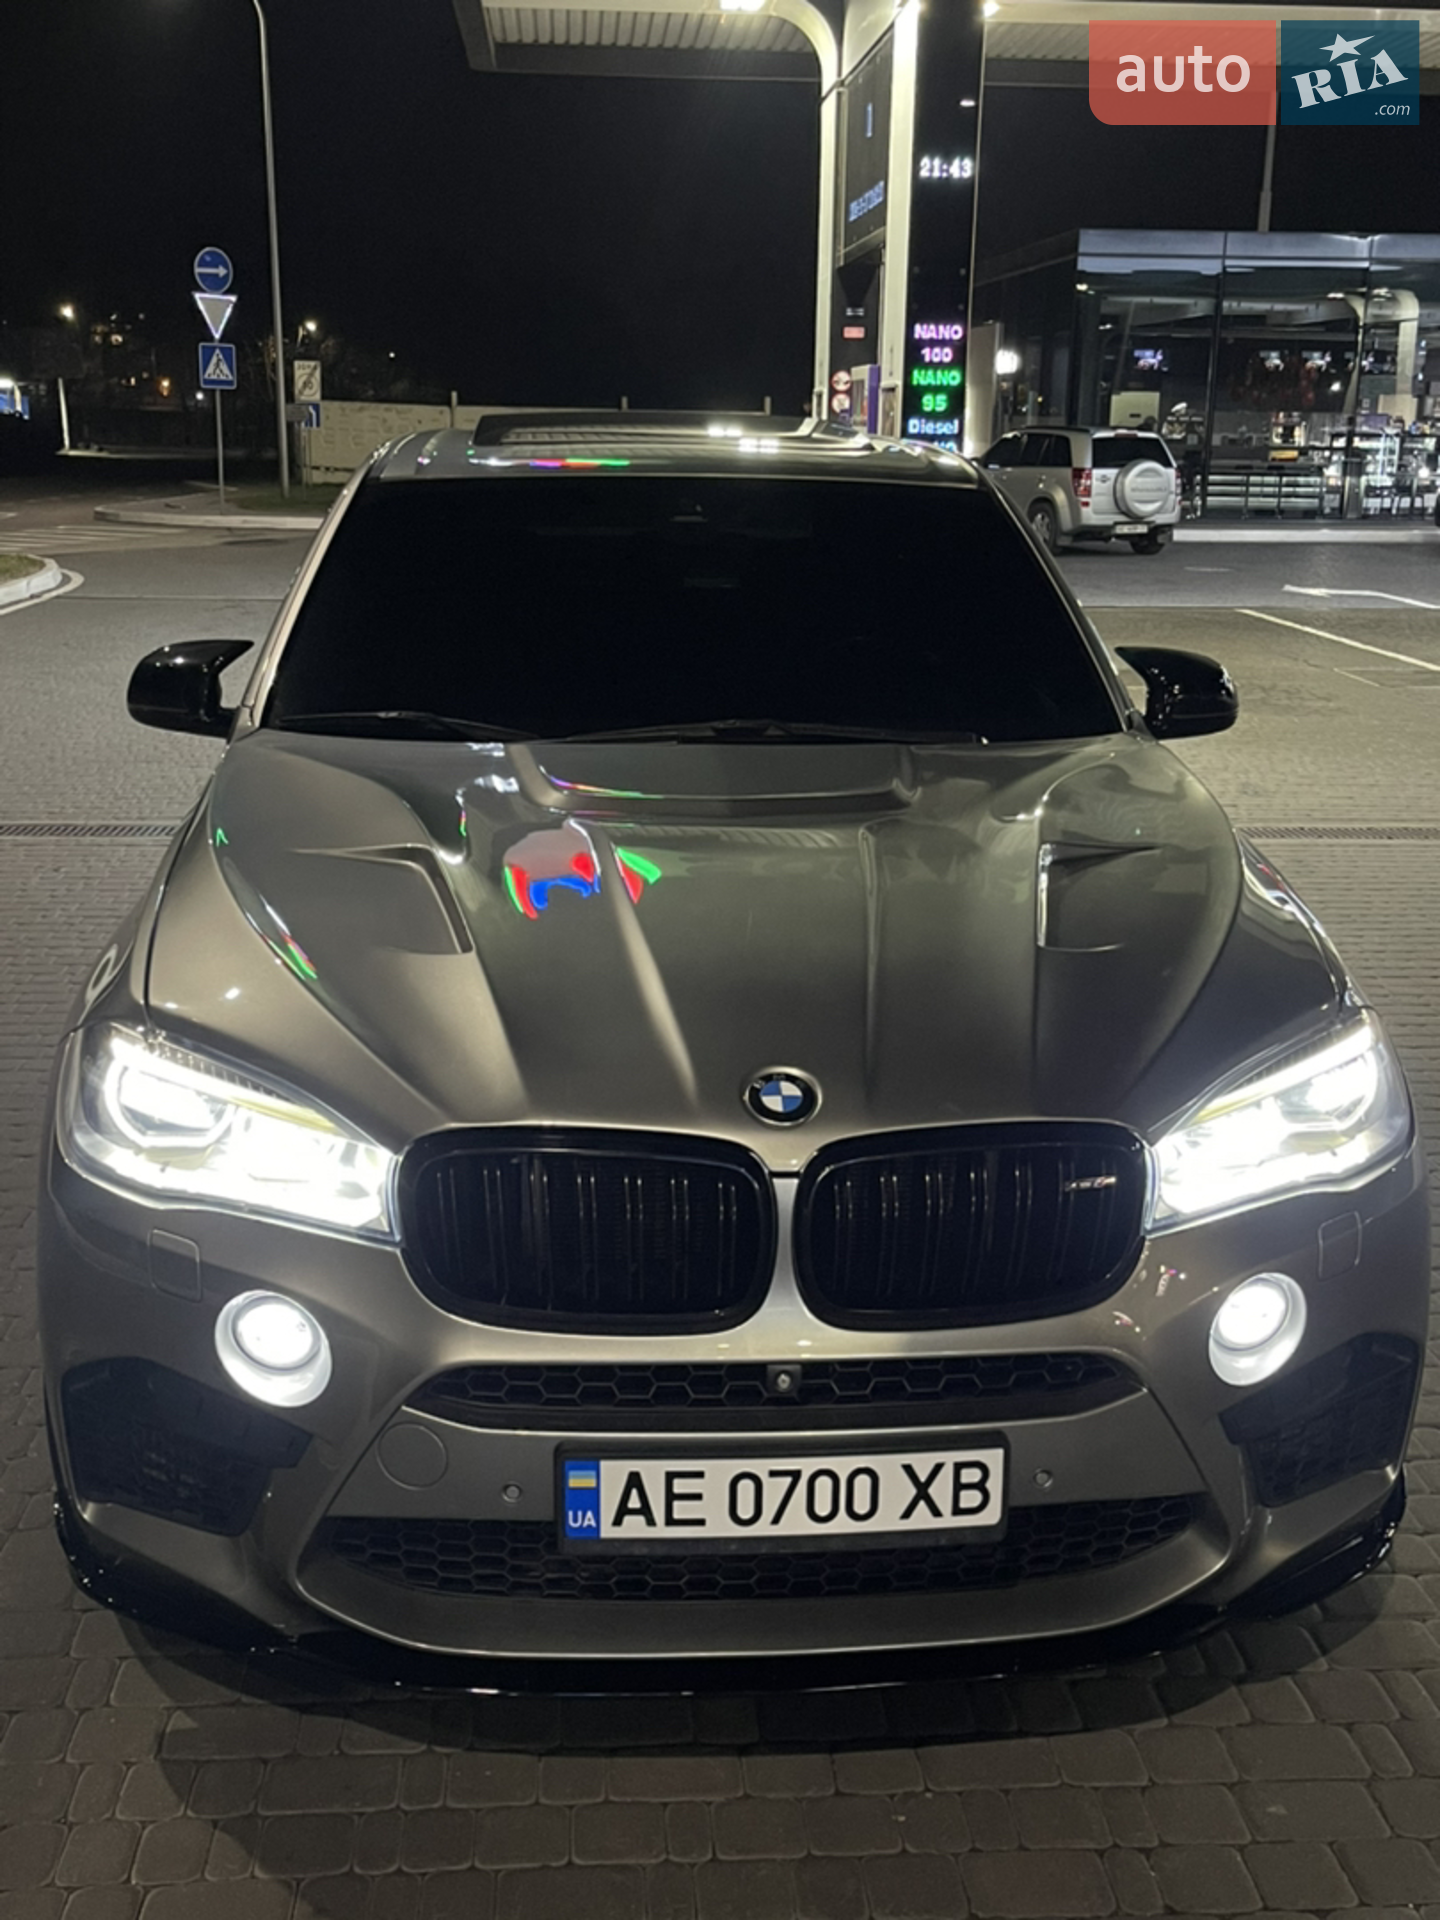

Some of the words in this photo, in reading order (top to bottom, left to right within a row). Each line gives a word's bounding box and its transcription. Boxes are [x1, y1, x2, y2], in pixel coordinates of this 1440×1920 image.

[919, 155, 974, 179] 21:43
[913, 323, 964, 340] NANO
[920, 346, 954, 363] 100
[911, 369, 962, 386] NANO
[921, 393, 948, 412] 95
[907, 418, 959, 434] Diesel
[611, 1469, 707, 1527] AE
[727, 1466, 880, 1528] 0700
[899, 1459, 991, 1521] XB
[568, 1510, 597, 1528] UA
